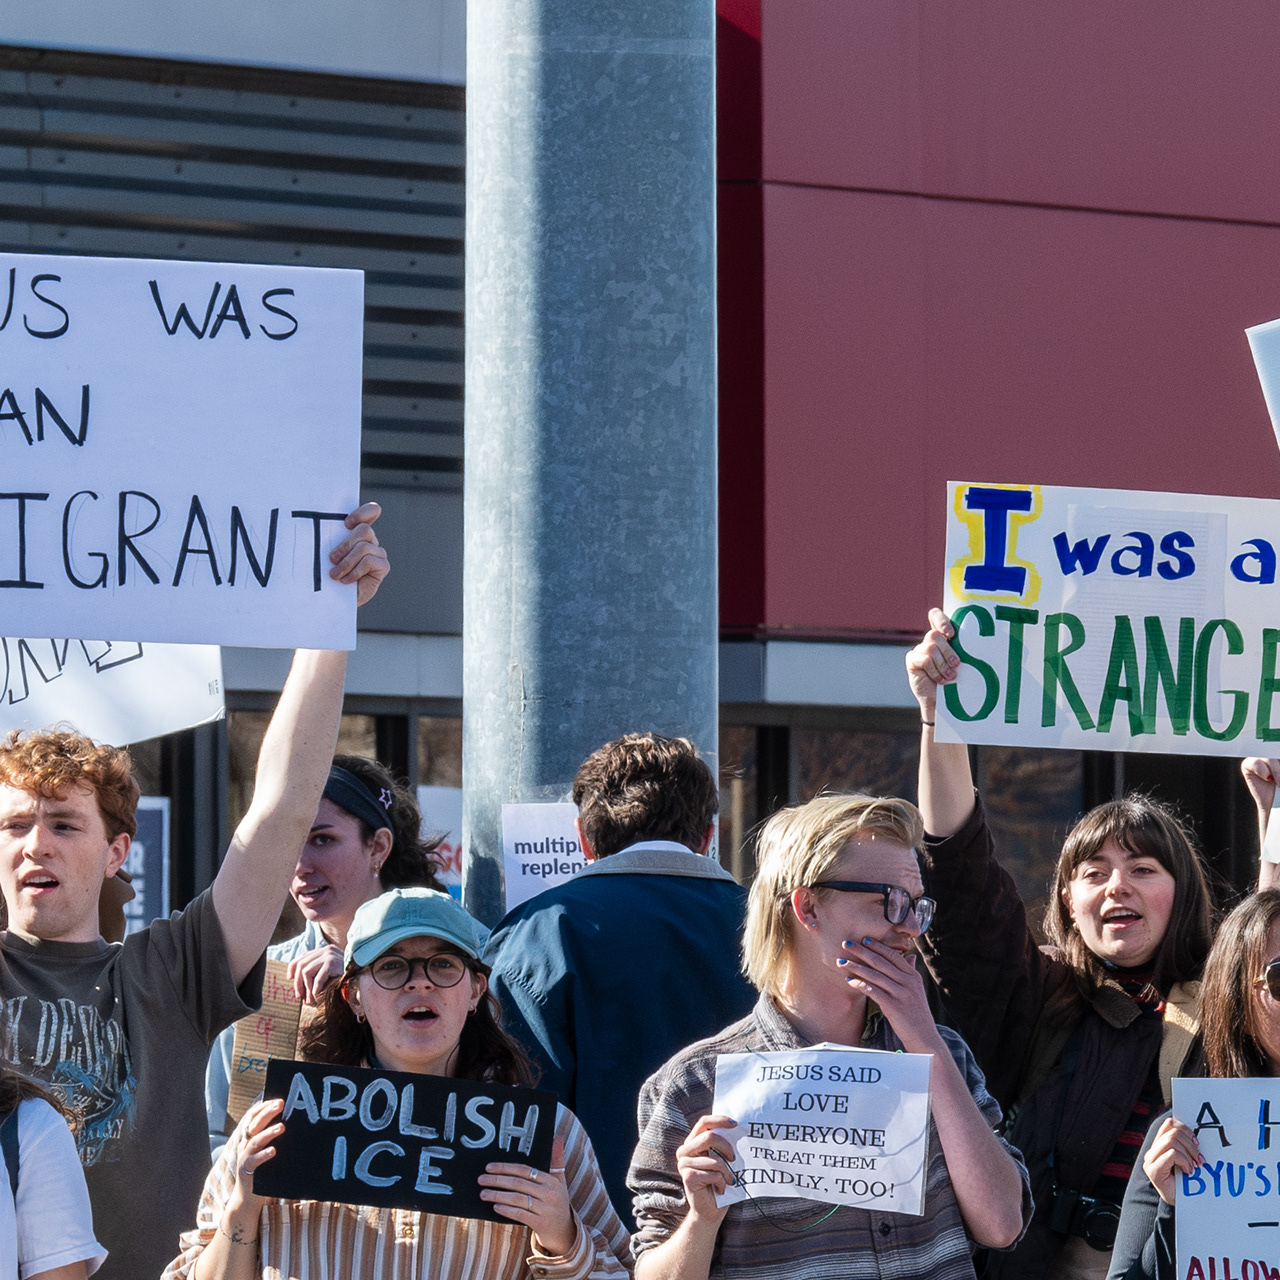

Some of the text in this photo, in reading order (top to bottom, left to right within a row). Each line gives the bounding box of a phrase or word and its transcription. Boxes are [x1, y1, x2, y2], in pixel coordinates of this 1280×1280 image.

[148, 280, 298, 340] WAS
[963, 486, 1277, 597] I was a
[757, 1063, 882, 1084] JESUS SAID
[283, 1072, 539, 1155] ABOLISH
[783, 1092, 849, 1114] LOVE
[748, 1121, 886, 1148] EVERYONE
[1193, 1102, 1231, 1147] A
[332, 1136, 455, 1195] ICE
[750, 1146, 877, 1170] TREAT THEM
[733, 1169, 895, 1199] KINDLY, TOO!
[1182, 1160, 1271, 1198] BYU'S
